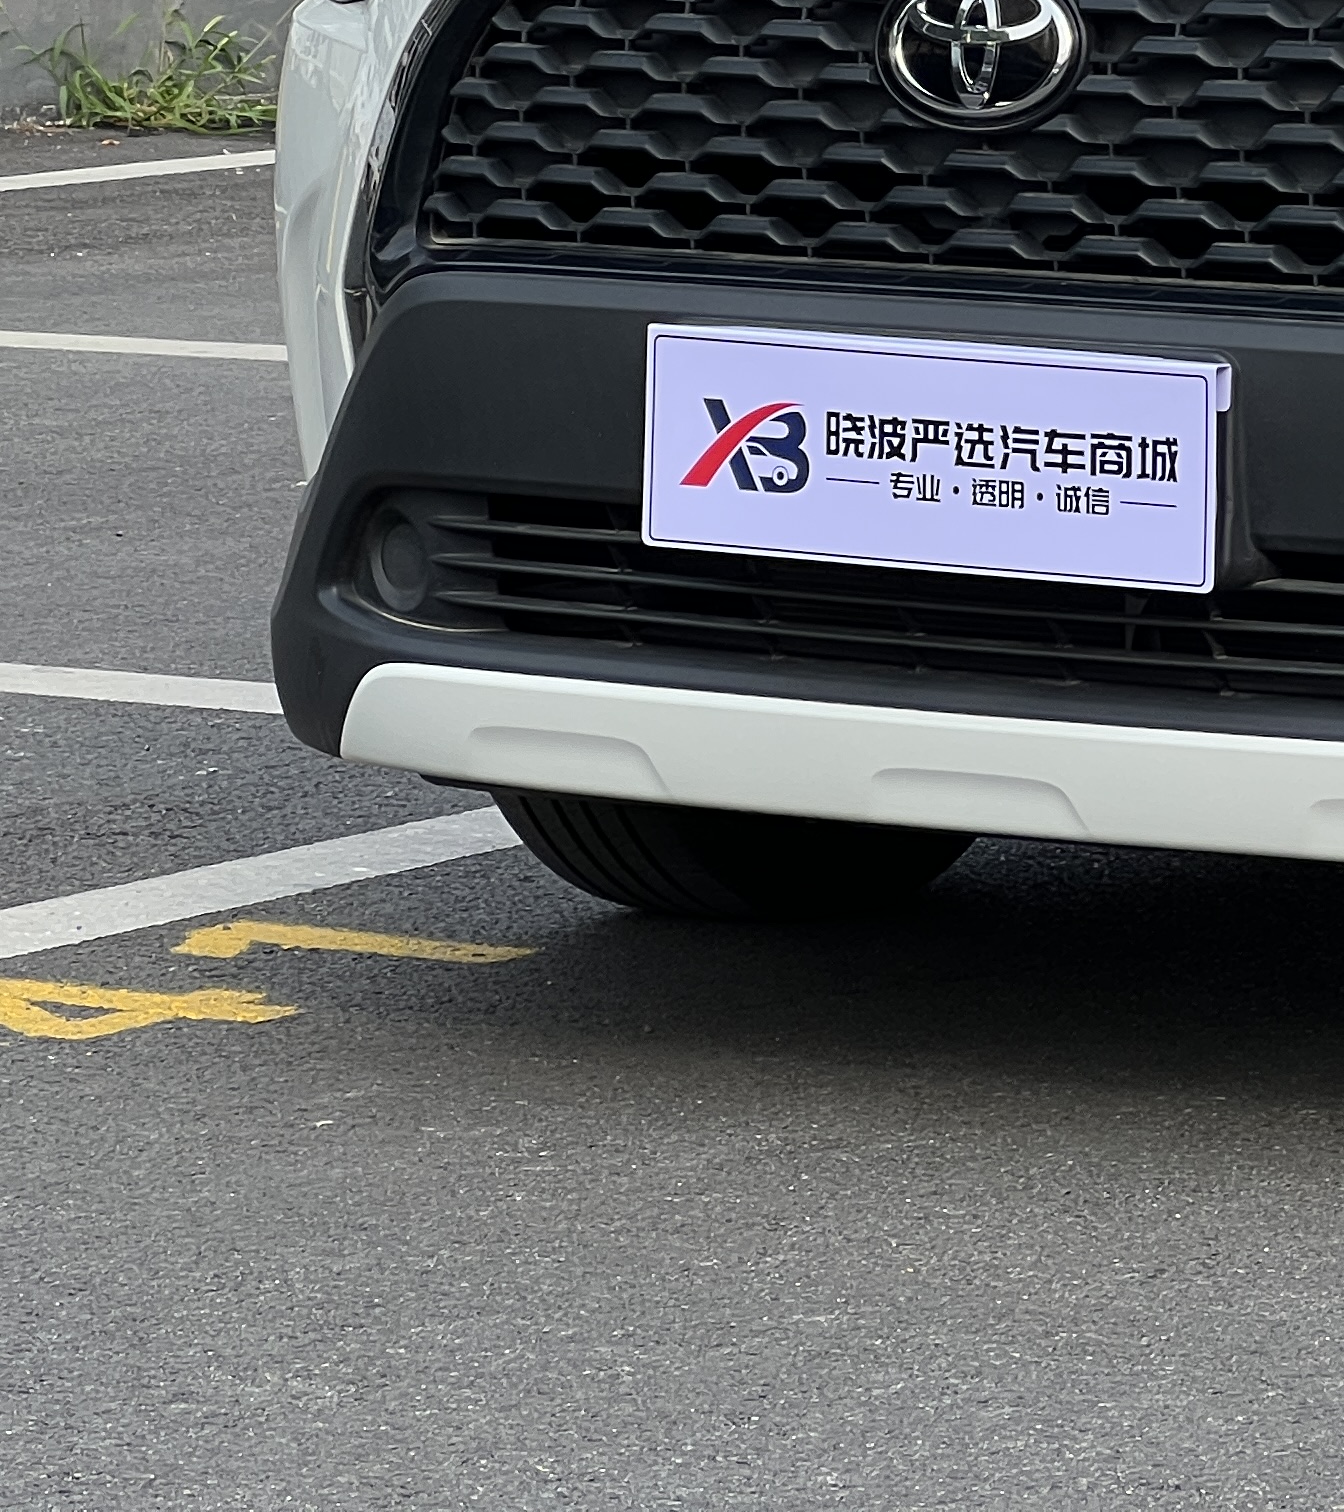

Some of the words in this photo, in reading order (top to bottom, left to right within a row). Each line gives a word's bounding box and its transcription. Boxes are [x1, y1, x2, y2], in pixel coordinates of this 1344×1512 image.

[826, 411, 1178, 483] 晓波严选汽车商城
